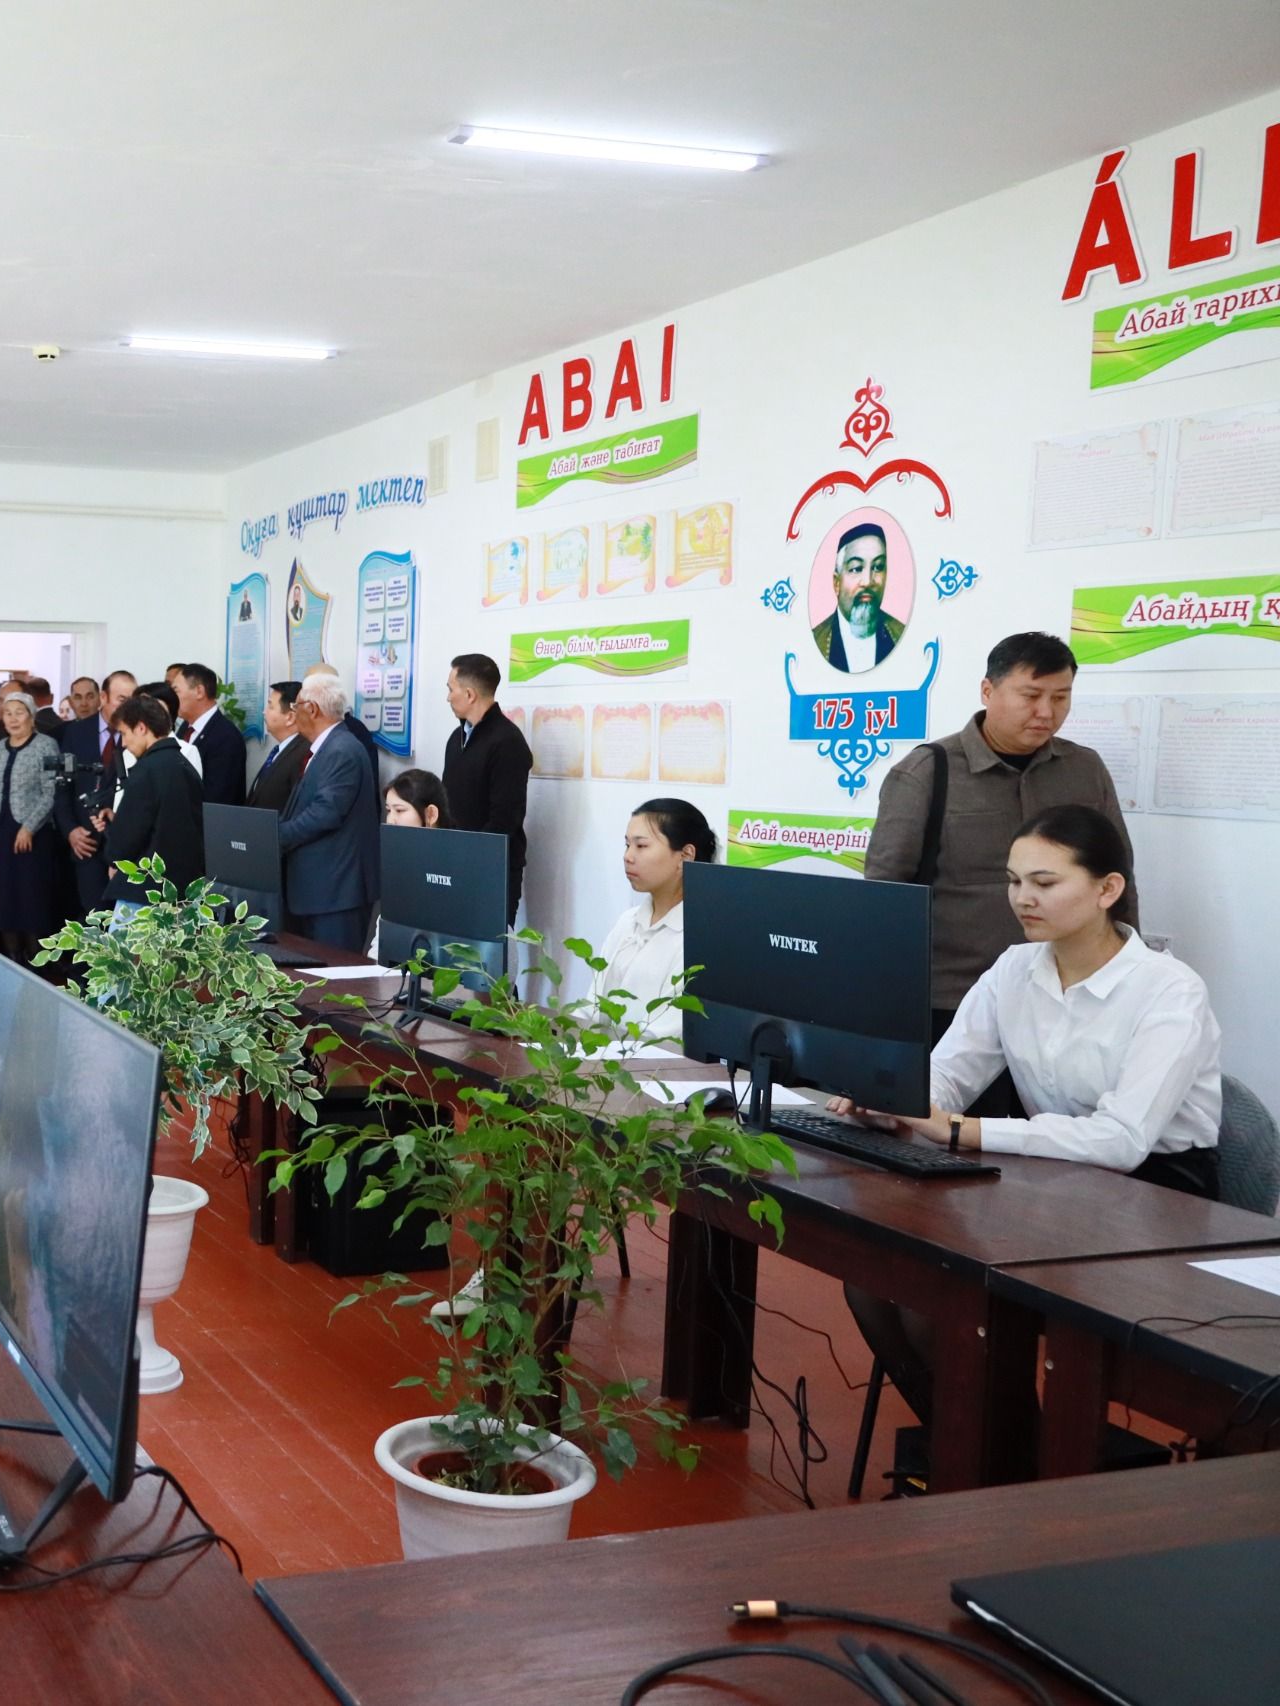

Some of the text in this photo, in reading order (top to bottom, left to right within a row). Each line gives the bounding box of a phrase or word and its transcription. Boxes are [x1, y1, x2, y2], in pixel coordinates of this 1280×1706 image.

[1119, 301, 1187, 338] Абай
[517, 323, 675, 446] ABAI
[548, 438, 661, 477] Абай және табиғат
[239, 476, 425, 558] Оқуға құштар мектеп
[1126, 597, 1250, 624] Абайдың
[535, 640, 564, 658] Өнер,
[567, 636, 597, 655] білім,
[599, 636, 650, 655] ғылымға
[813, 697, 896, 735] 175 jyl
[740, 823, 871, 851] Абай өлеңдеріні
[425, 872, 452, 886] WINTEK
[768, 933, 819, 955] WINTEK
